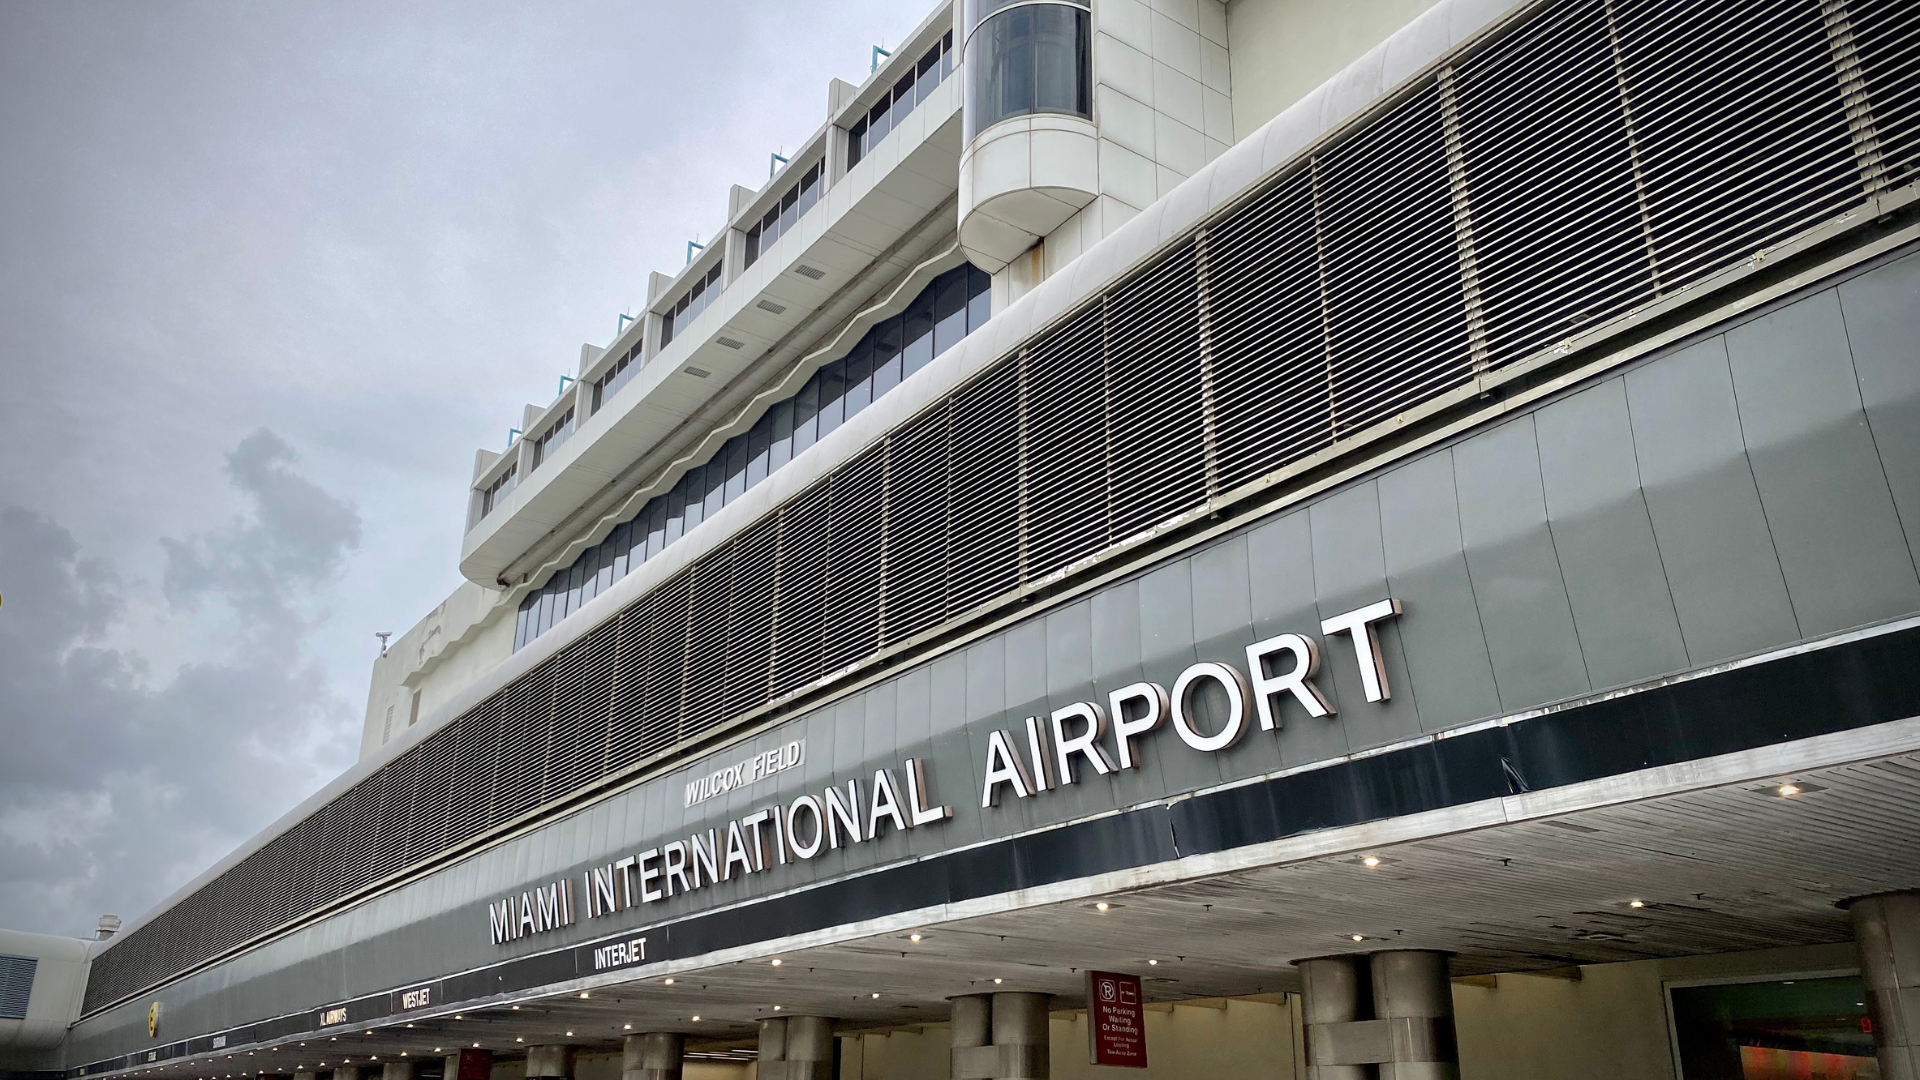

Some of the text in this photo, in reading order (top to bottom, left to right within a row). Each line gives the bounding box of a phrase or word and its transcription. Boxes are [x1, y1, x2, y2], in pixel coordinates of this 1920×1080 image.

[489, 599, 1401, 946] MIAMI INTERNATIONAL AIRPORT
[686, 741, 801, 805] WILCOX FIELD
[594, 937, 647, 970] INTERJET
[402, 988, 431, 1009] WESTJET
[326, 1007, 347, 1025] AIRWAYS
[1102, 1006, 1135, 1017] No Parking
[1109, 1015, 1132, 1026] Waiting
[1102, 1023, 1139, 1036] Or Standing
